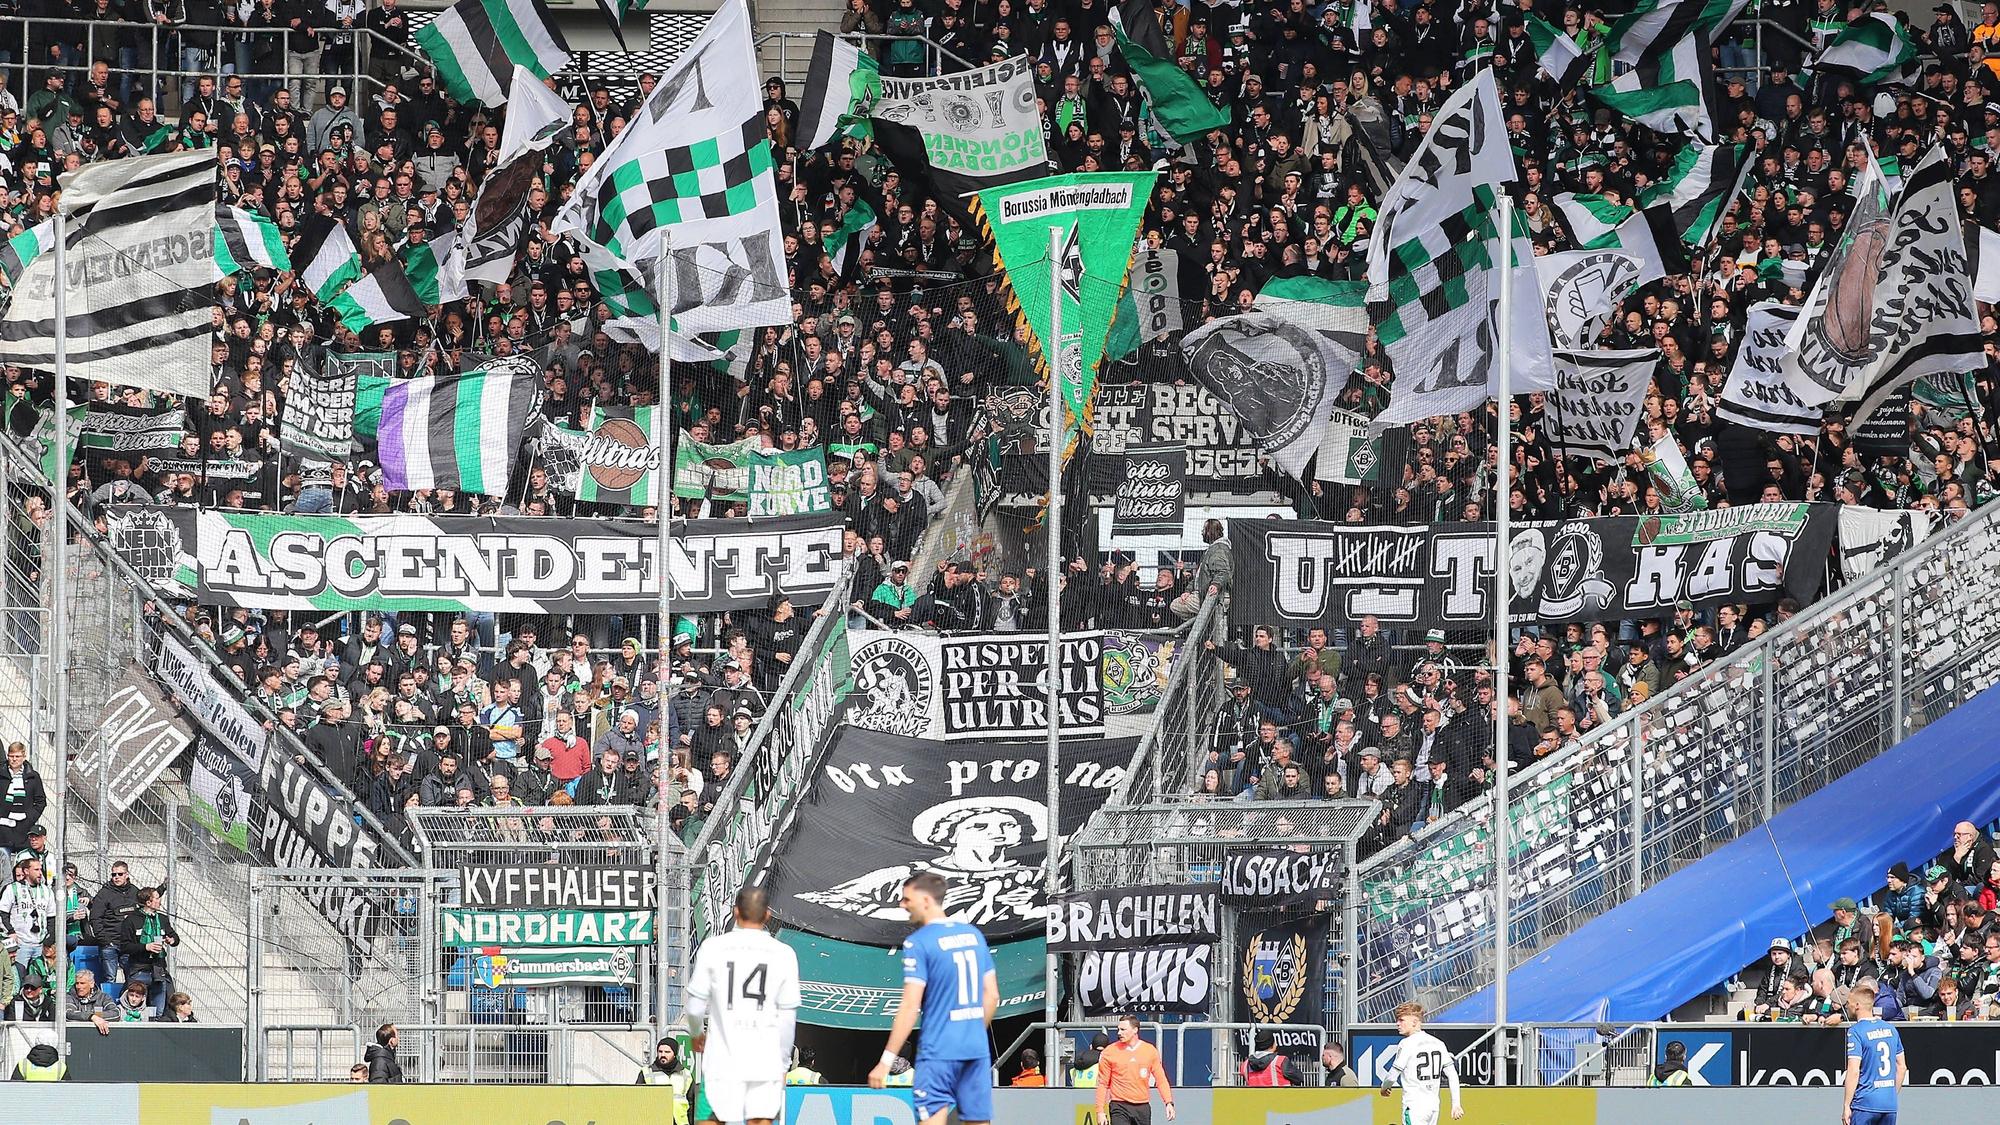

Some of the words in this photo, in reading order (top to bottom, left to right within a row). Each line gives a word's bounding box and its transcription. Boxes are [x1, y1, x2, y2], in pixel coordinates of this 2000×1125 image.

[1004, 193, 1048, 218] Borussia
[281, 406, 310, 431] BEI
[753, 459, 824, 492] NORD
[750, 486, 831, 516] KURVE
[116, 530, 172, 549] NEUN
[1560, 521, 1590, 536] 1900
[205, 525, 846, 602] ASCENDENTE
[947, 670, 1021, 699] PER
[948, 695, 1099, 730] ULTRAS
[210, 702, 258, 759] Fohlen
[944, 759, 1041, 798] pro
[463, 865, 658, 908] KYFFHÄUSER
[444, 910, 651, 943] NORDHARZ
[1046, 893, 1216, 944] BRACHELEN
[508, 958, 610, 975] Gummersbach
[952, 949, 980, 1006] 11
[1079, 944, 1212, 1008] PINKIS
[726, 961, 768, 1011] 14
[996, 990, 1046, 1008] rena
[1416, 1050, 1441, 1081] 20
[1877, 1040, 1892, 1079] 3
